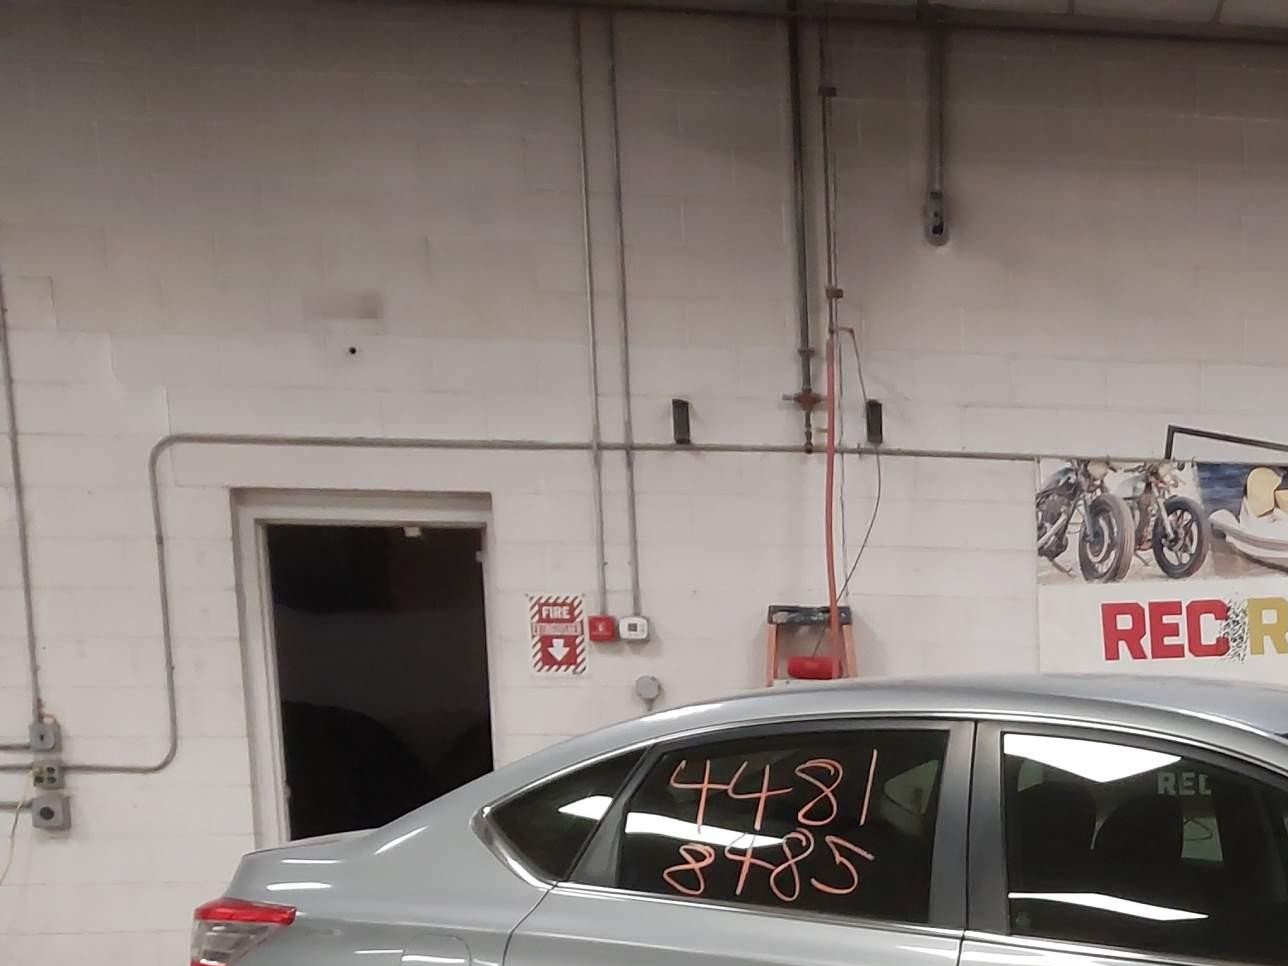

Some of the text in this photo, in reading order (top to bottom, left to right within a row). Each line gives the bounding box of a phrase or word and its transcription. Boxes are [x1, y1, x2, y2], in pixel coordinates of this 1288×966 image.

[542, 605, 571, 619] FIRE
[1101, 600, 1230, 661] REC
[670, 749, 878, 834] 4481
[663, 828, 874, 901] 8485
